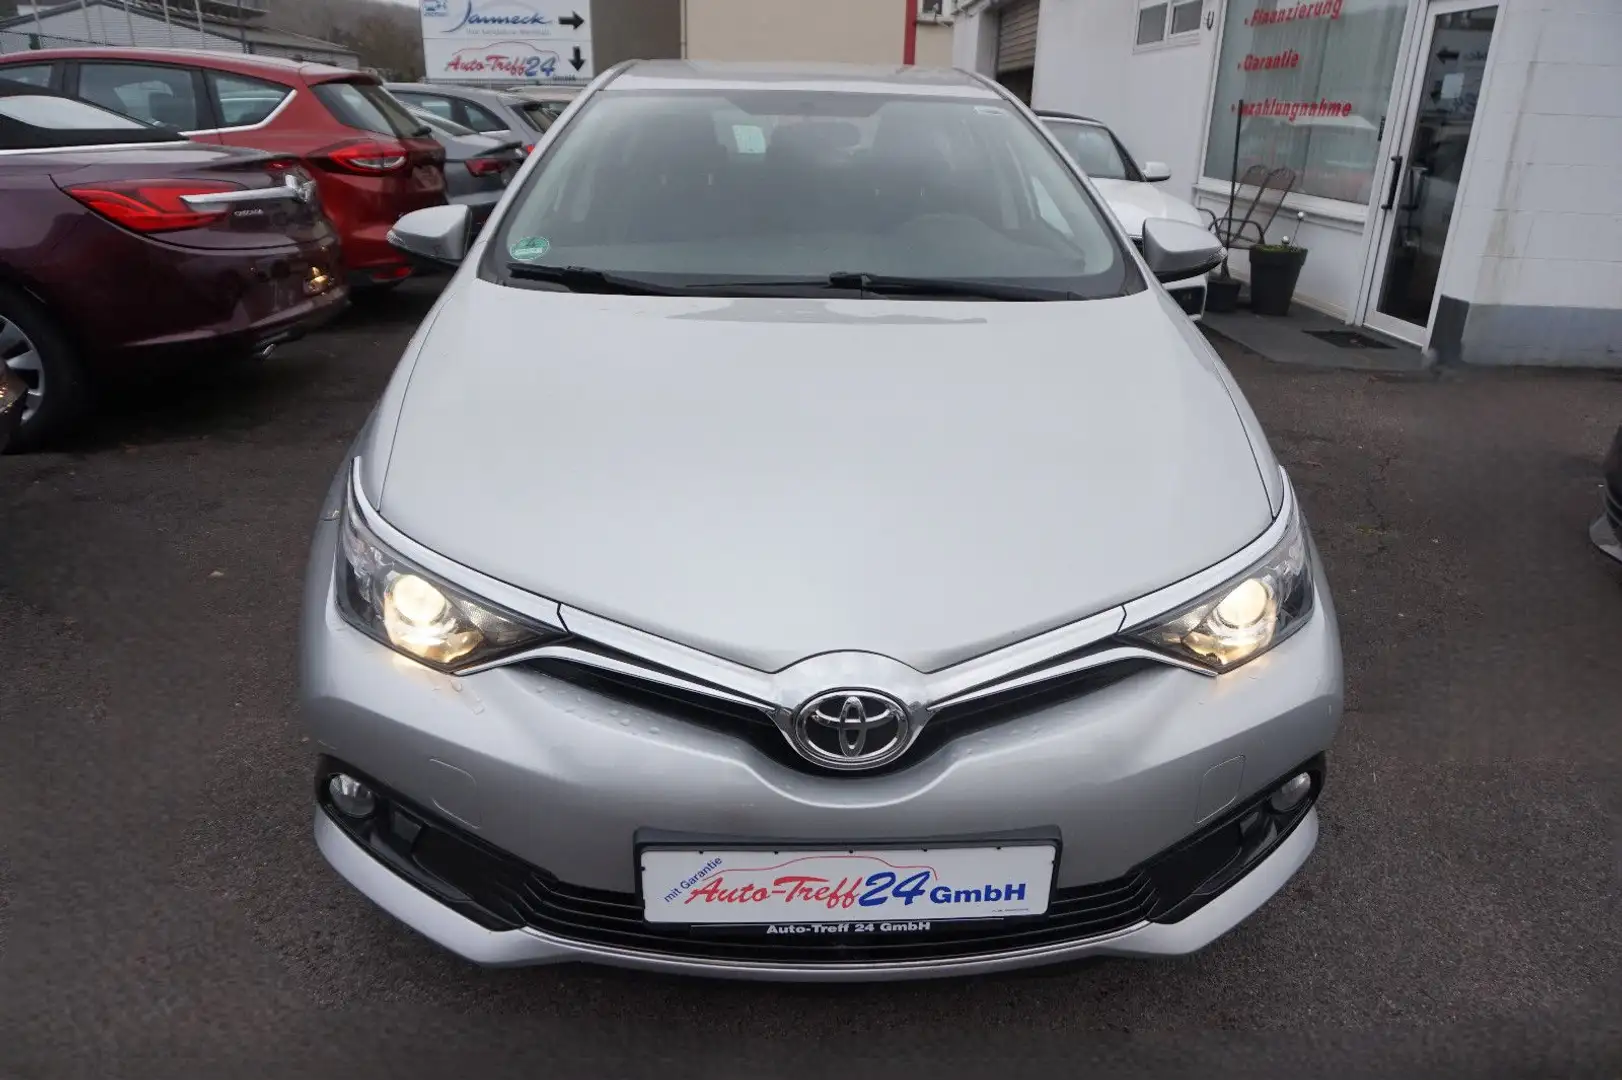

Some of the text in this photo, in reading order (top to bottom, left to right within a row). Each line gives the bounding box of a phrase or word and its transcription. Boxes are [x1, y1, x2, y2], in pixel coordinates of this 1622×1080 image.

[1250, 0, 1344, 27] Finanzierung
[1244, 48, 1301, 72] Garantie
[1238, 97, 1352, 122] nzahlungnahme
[663, 857, 723, 903] mit Garantie
[930, 883, 1027, 904] GmbH
[766, 921, 931, 934] Auto-Treff 24 GmbH
